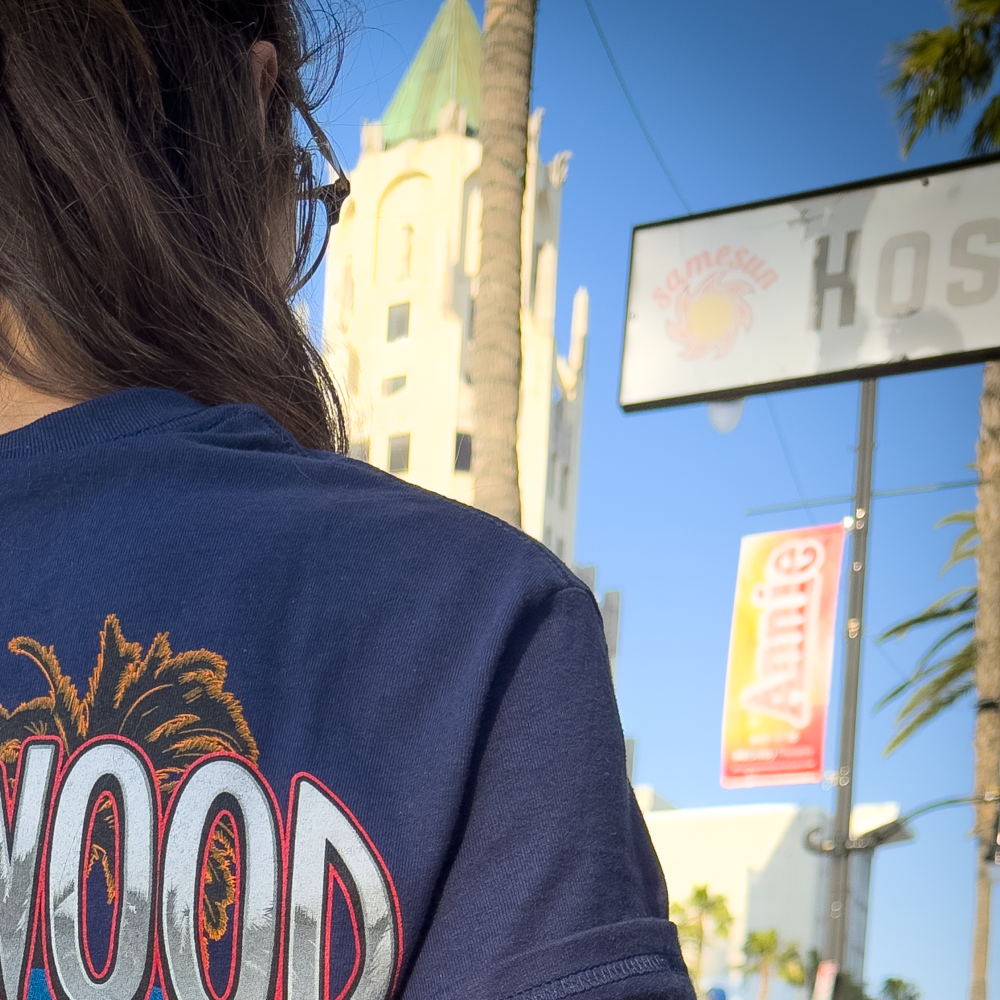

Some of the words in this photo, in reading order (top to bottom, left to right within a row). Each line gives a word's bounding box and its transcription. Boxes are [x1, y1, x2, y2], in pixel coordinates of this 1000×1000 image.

[652, 244, 779, 311] samesun
[812, 217, 1000, 331] HOS
[739, 536, 827, 731] Annie
